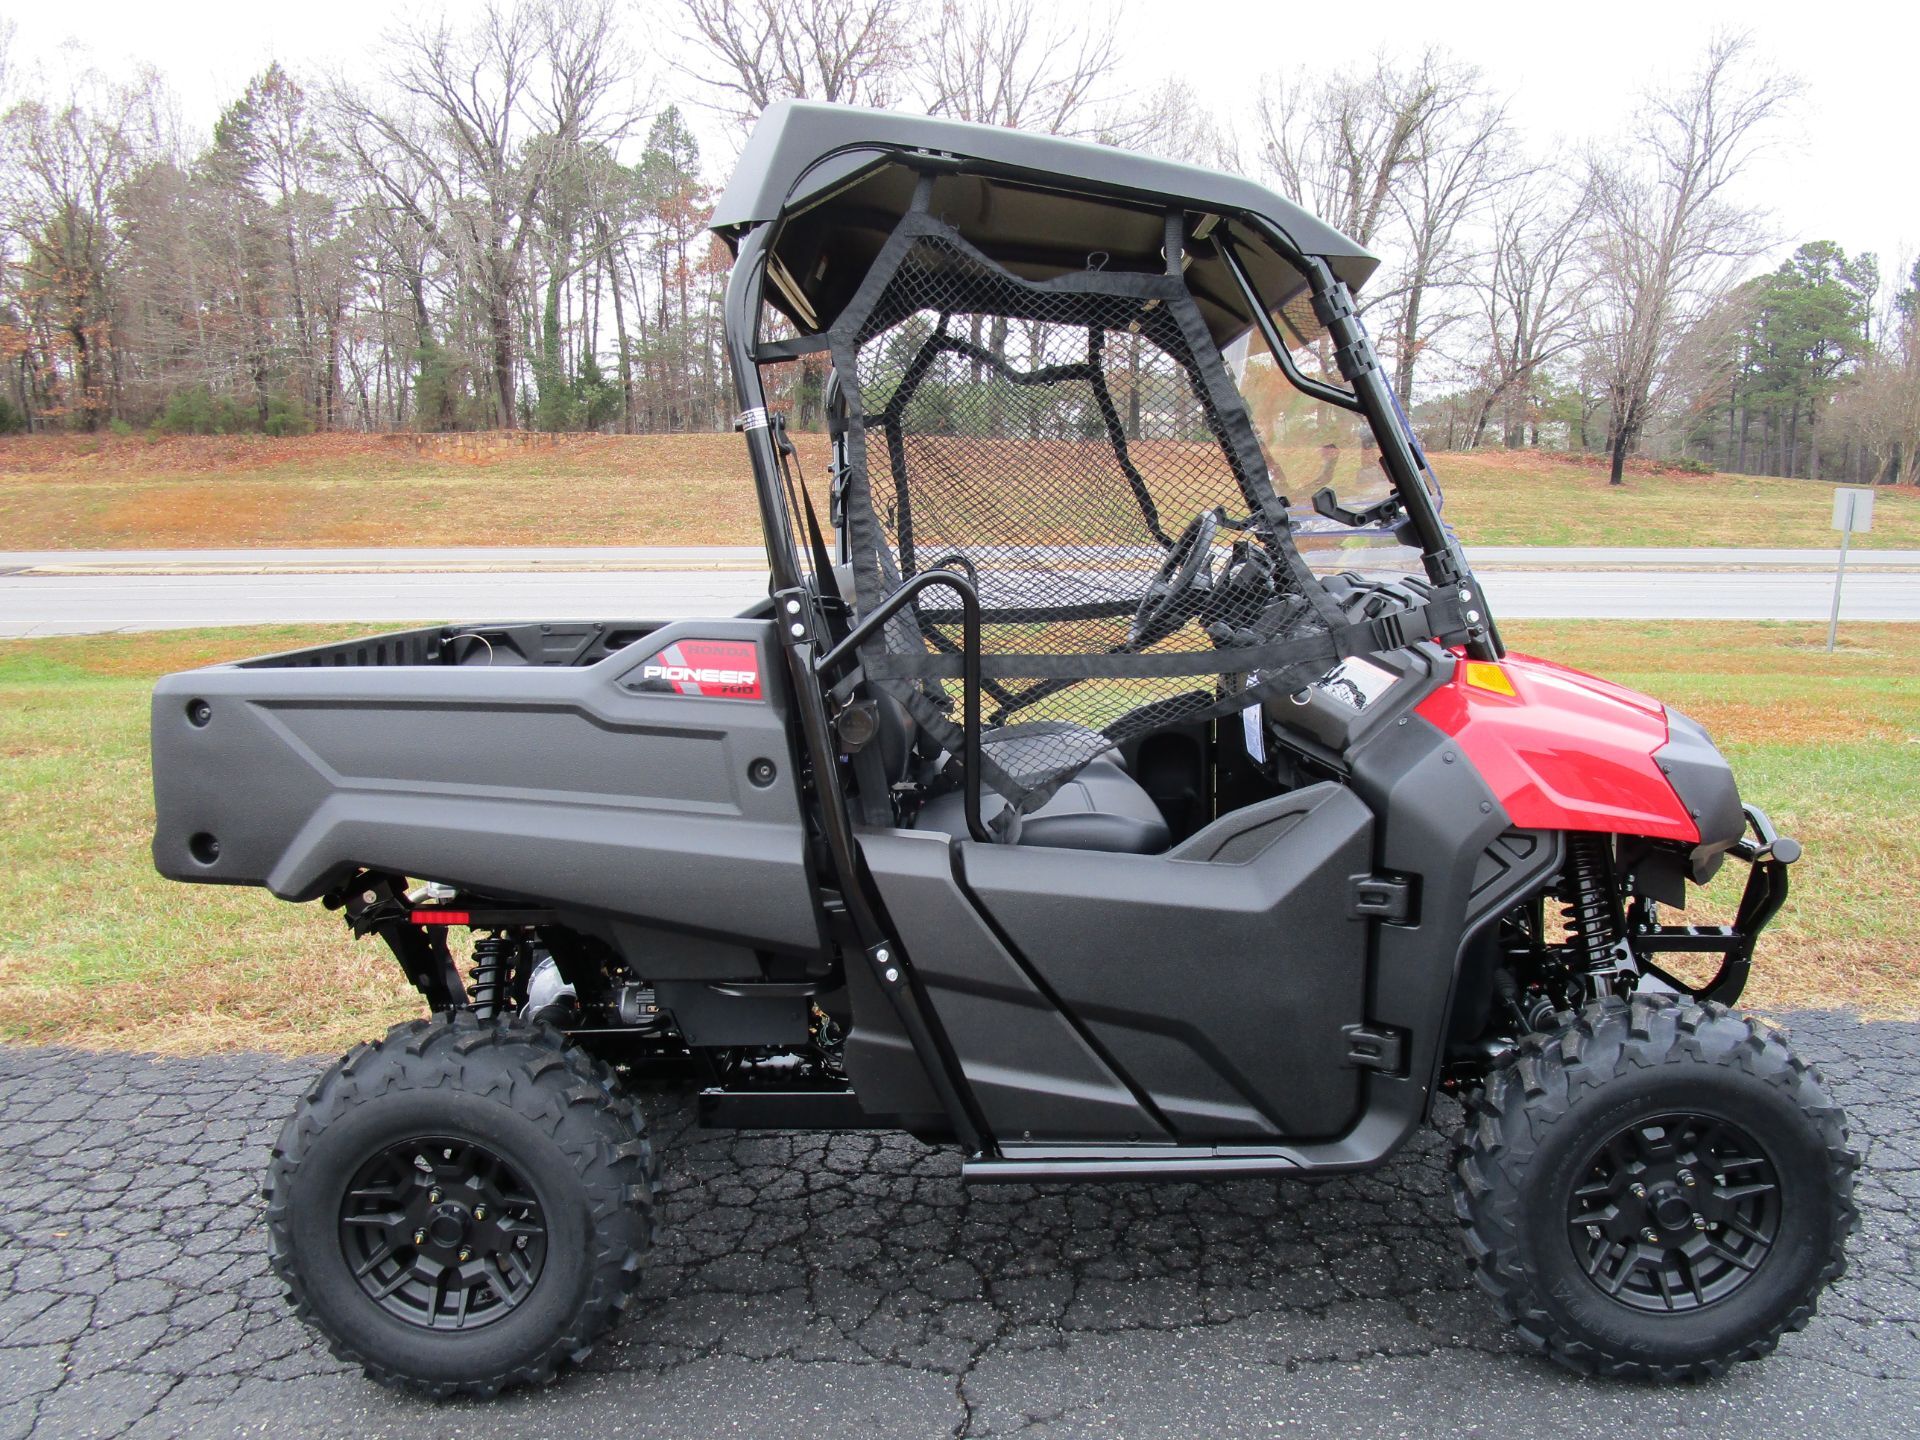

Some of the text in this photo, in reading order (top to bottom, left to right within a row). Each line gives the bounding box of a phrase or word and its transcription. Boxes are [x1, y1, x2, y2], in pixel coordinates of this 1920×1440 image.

[687, 645, 750, 657] HONDA
[643, 665, 756, 685] PIONEER
[720, 685, 754, 695] 700
